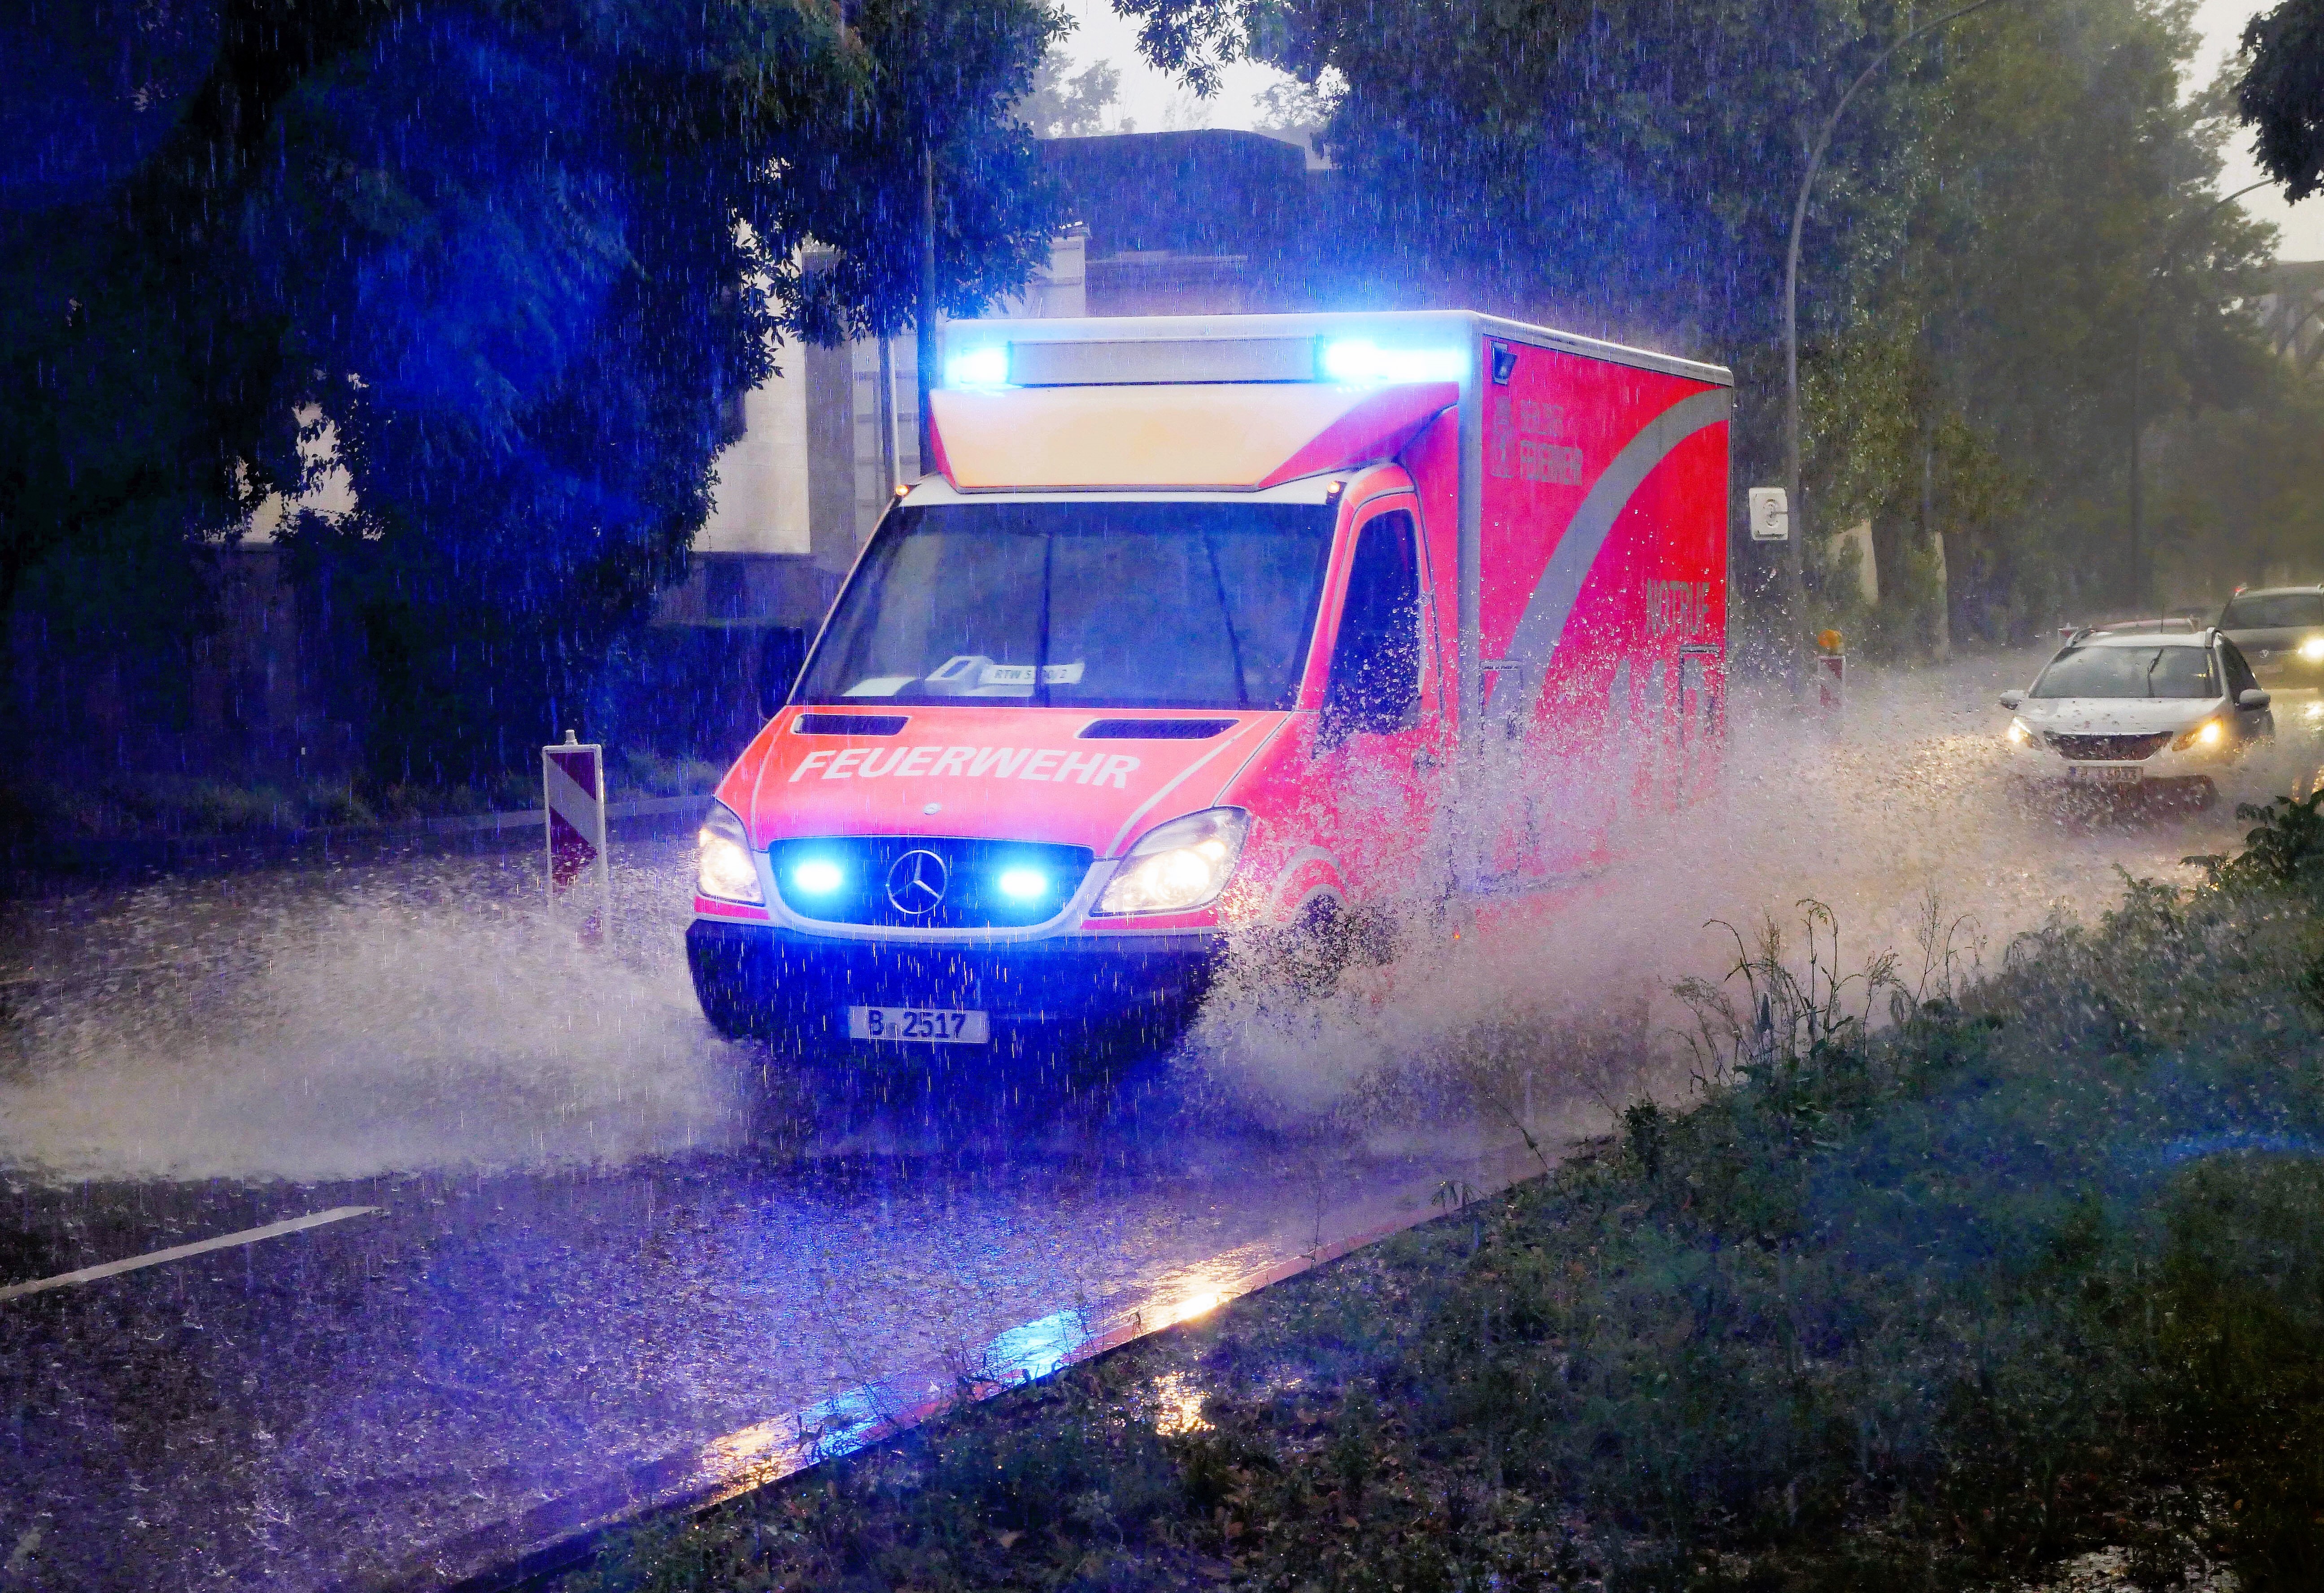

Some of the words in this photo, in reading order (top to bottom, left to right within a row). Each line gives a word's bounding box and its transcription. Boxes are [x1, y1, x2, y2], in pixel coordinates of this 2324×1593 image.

[1646, 579, 1710, 635] NOTRUF
[994, 669, 1021, 679] RTW
[788, 746, 1141, 789] FEUERWEHR
[868, 1010, 884, 1036] B
[903, 1010, 966, 1039] 2517
